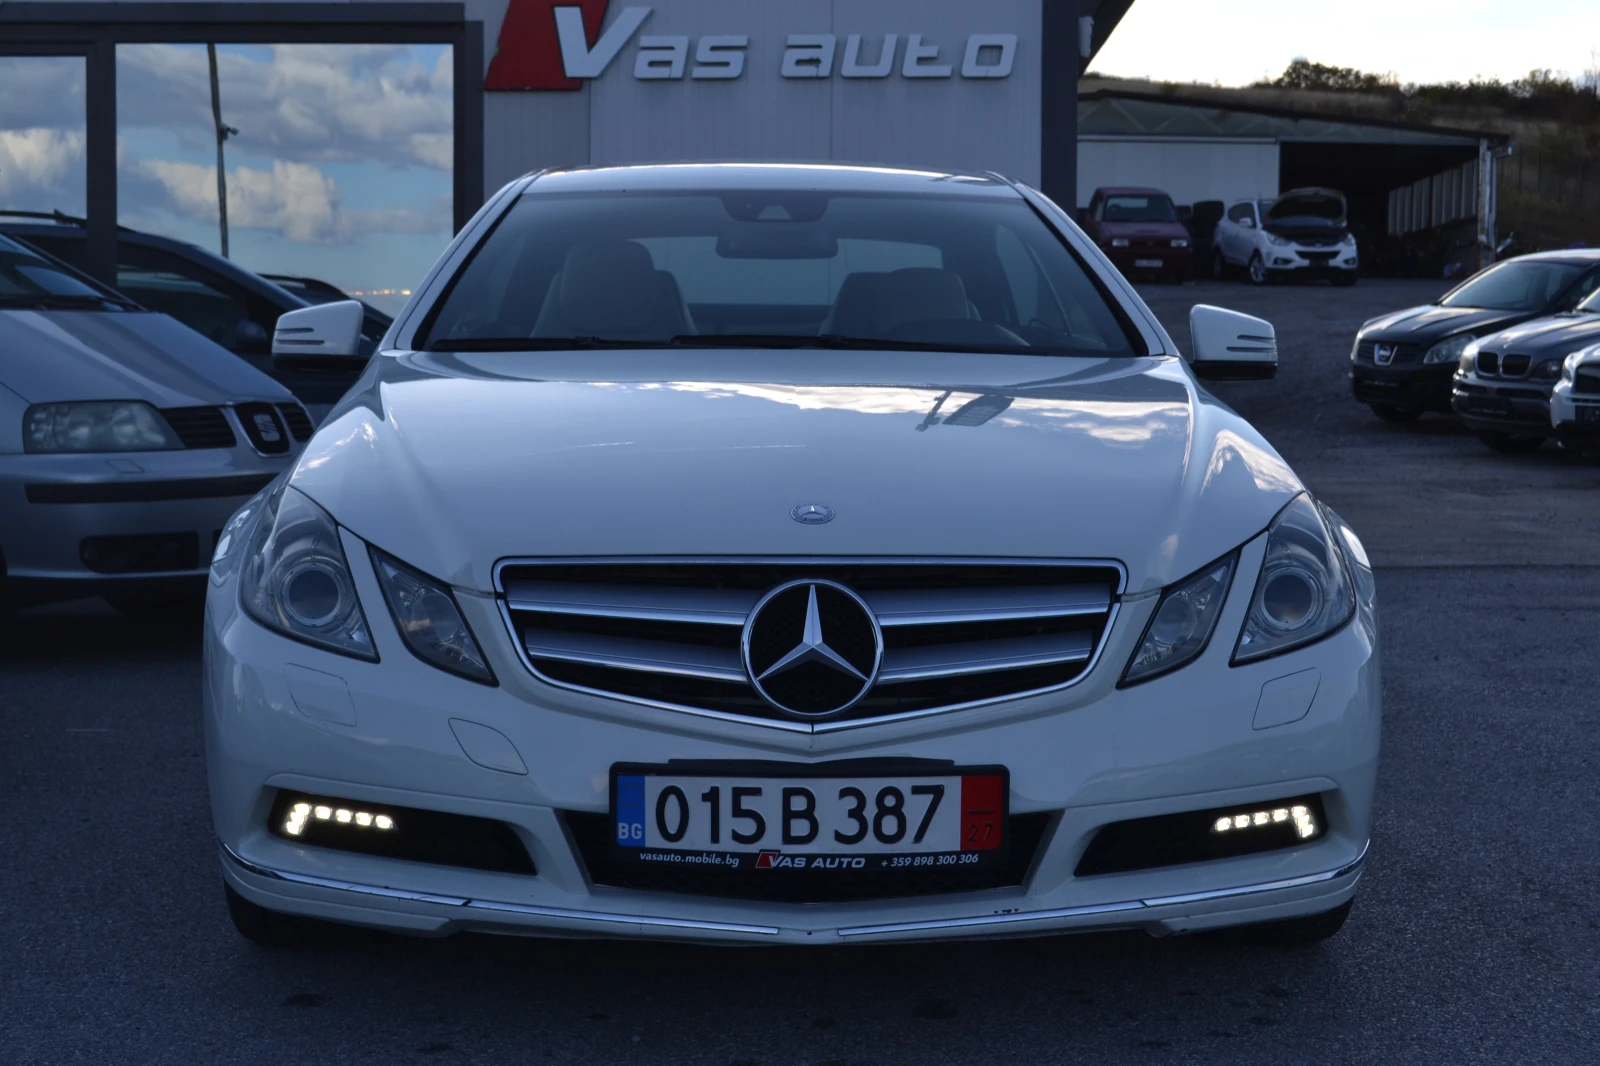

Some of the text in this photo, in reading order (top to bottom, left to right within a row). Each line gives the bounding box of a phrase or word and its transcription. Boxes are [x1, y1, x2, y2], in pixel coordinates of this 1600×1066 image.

[554, 5, 1018, 79] Vas auto
[656, 785, 945, 845] 015 B 387
[618, 822, 642, 839] BG
[968, 823, 994, 842] 27
[640, 852, 740, 868] vasauto.mobile.bg
[768, 855, 866, 868] VAS AUTO
[890, 857, 912, 867] 359
[913, 856, 934, 866] 898
[936, 855, 957, 866] 300
[958, 853, 979, 864] 306
